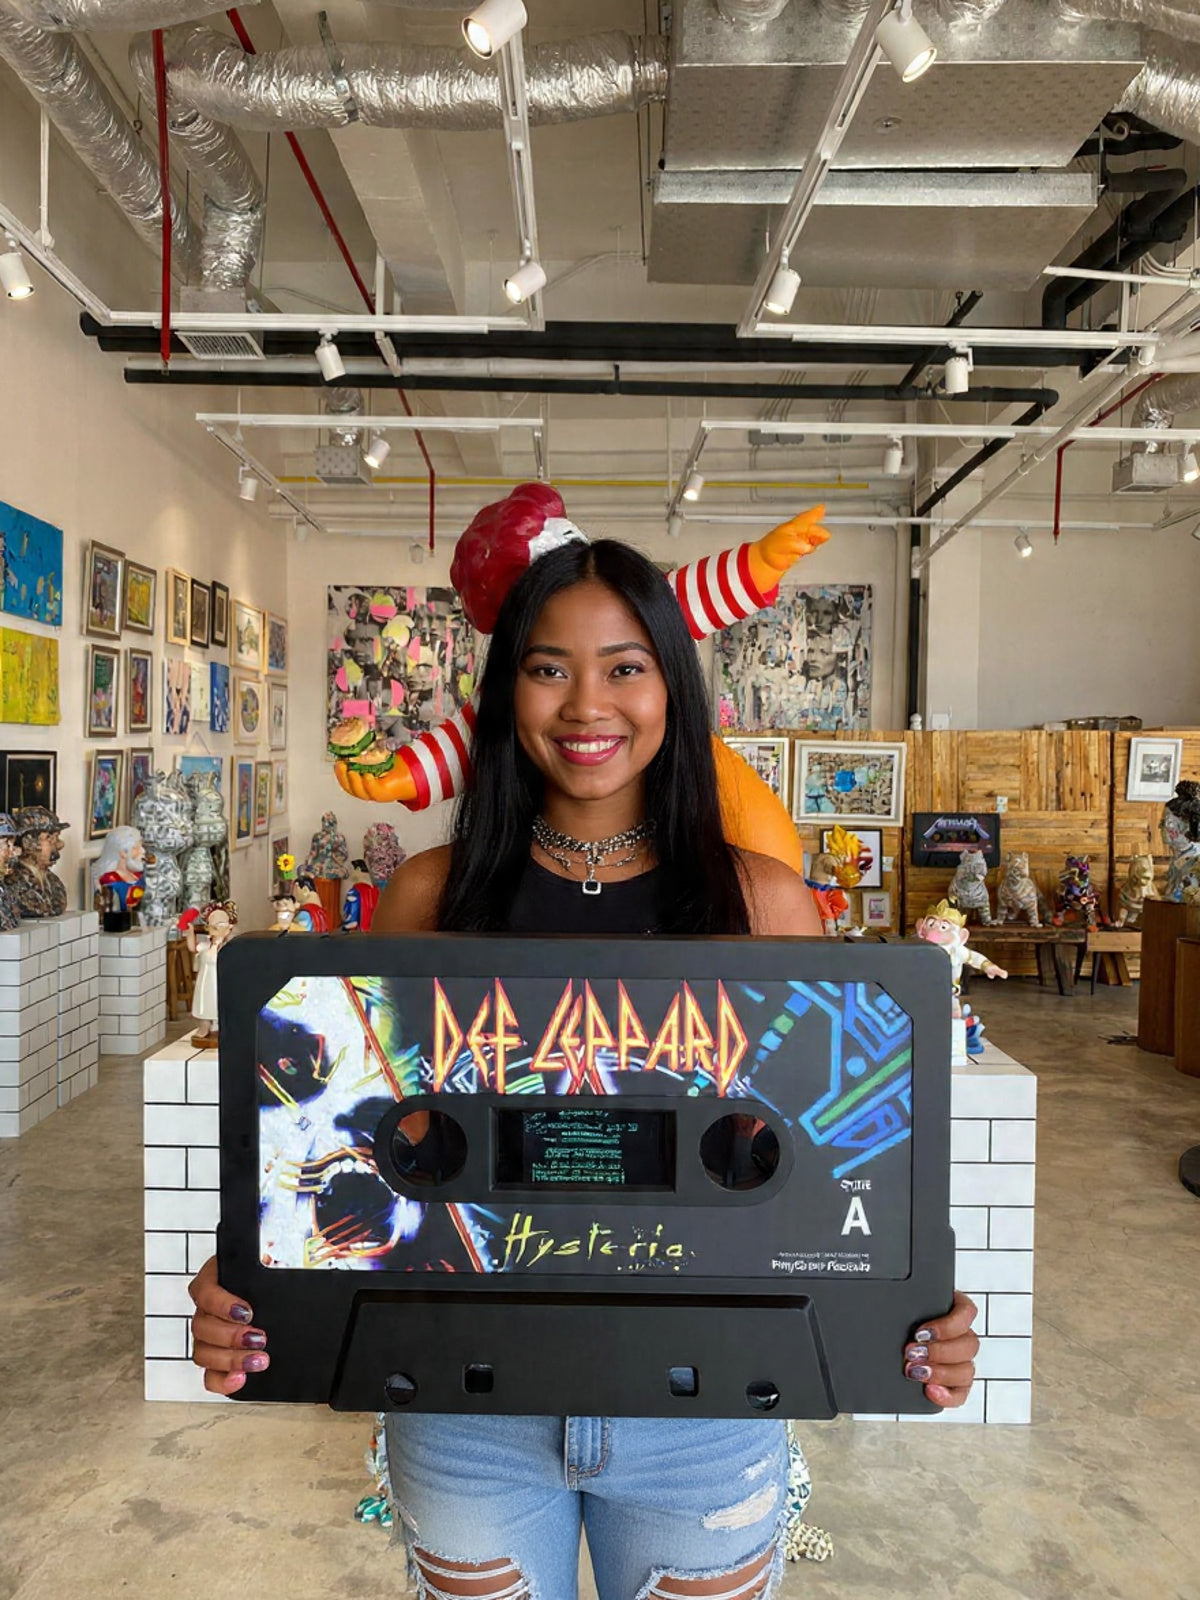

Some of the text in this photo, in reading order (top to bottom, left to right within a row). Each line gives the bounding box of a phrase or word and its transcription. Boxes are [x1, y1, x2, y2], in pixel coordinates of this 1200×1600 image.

[433, 977, 748, 1097] DEF LEPPARD
[841, 1196, 872, 1236] A
